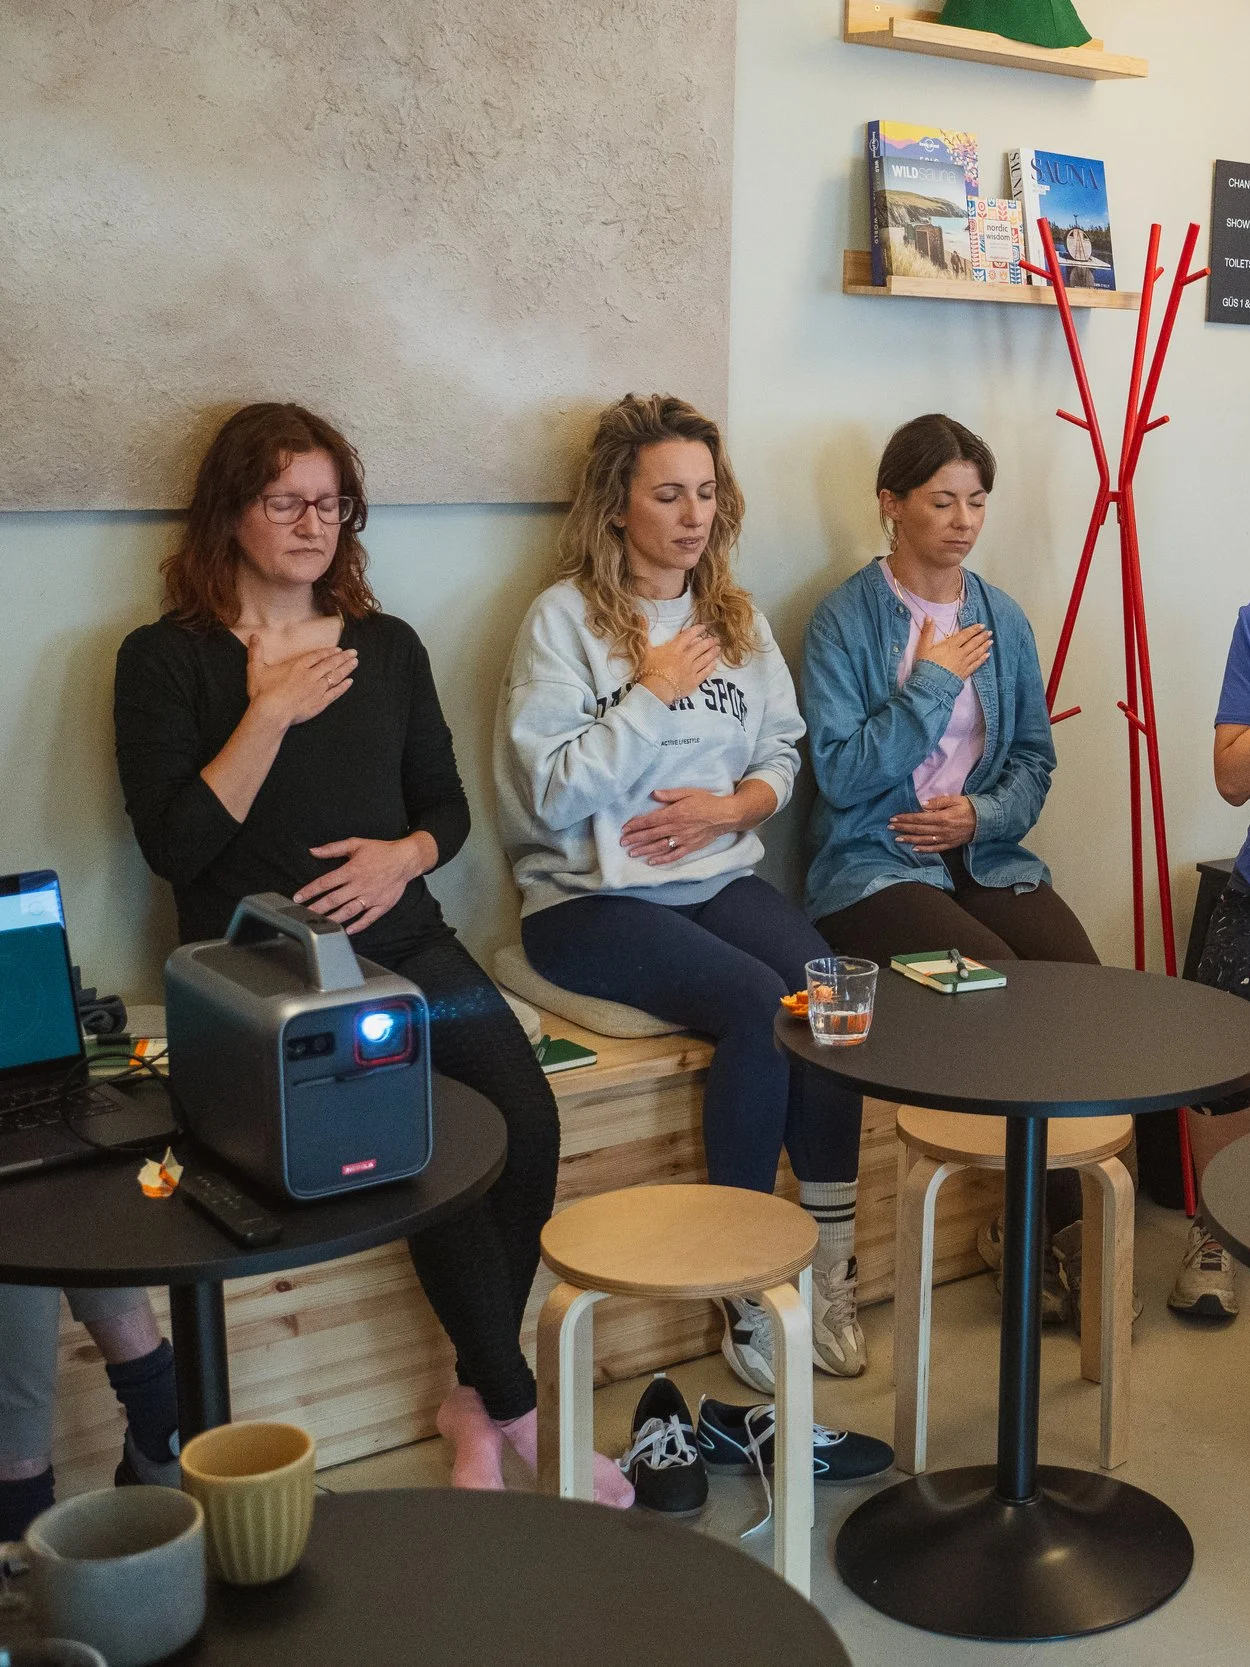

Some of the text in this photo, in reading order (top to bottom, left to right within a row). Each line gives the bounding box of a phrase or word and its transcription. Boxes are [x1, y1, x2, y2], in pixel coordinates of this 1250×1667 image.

[1031, 158, 1099, 190] SAUNA
[986, 223, 1009, 233] nordic
[986, 233, 1011, 241] wisdom
[1240, 299, 1244, 308] 1
[1244, 299, 1250, 309] &
